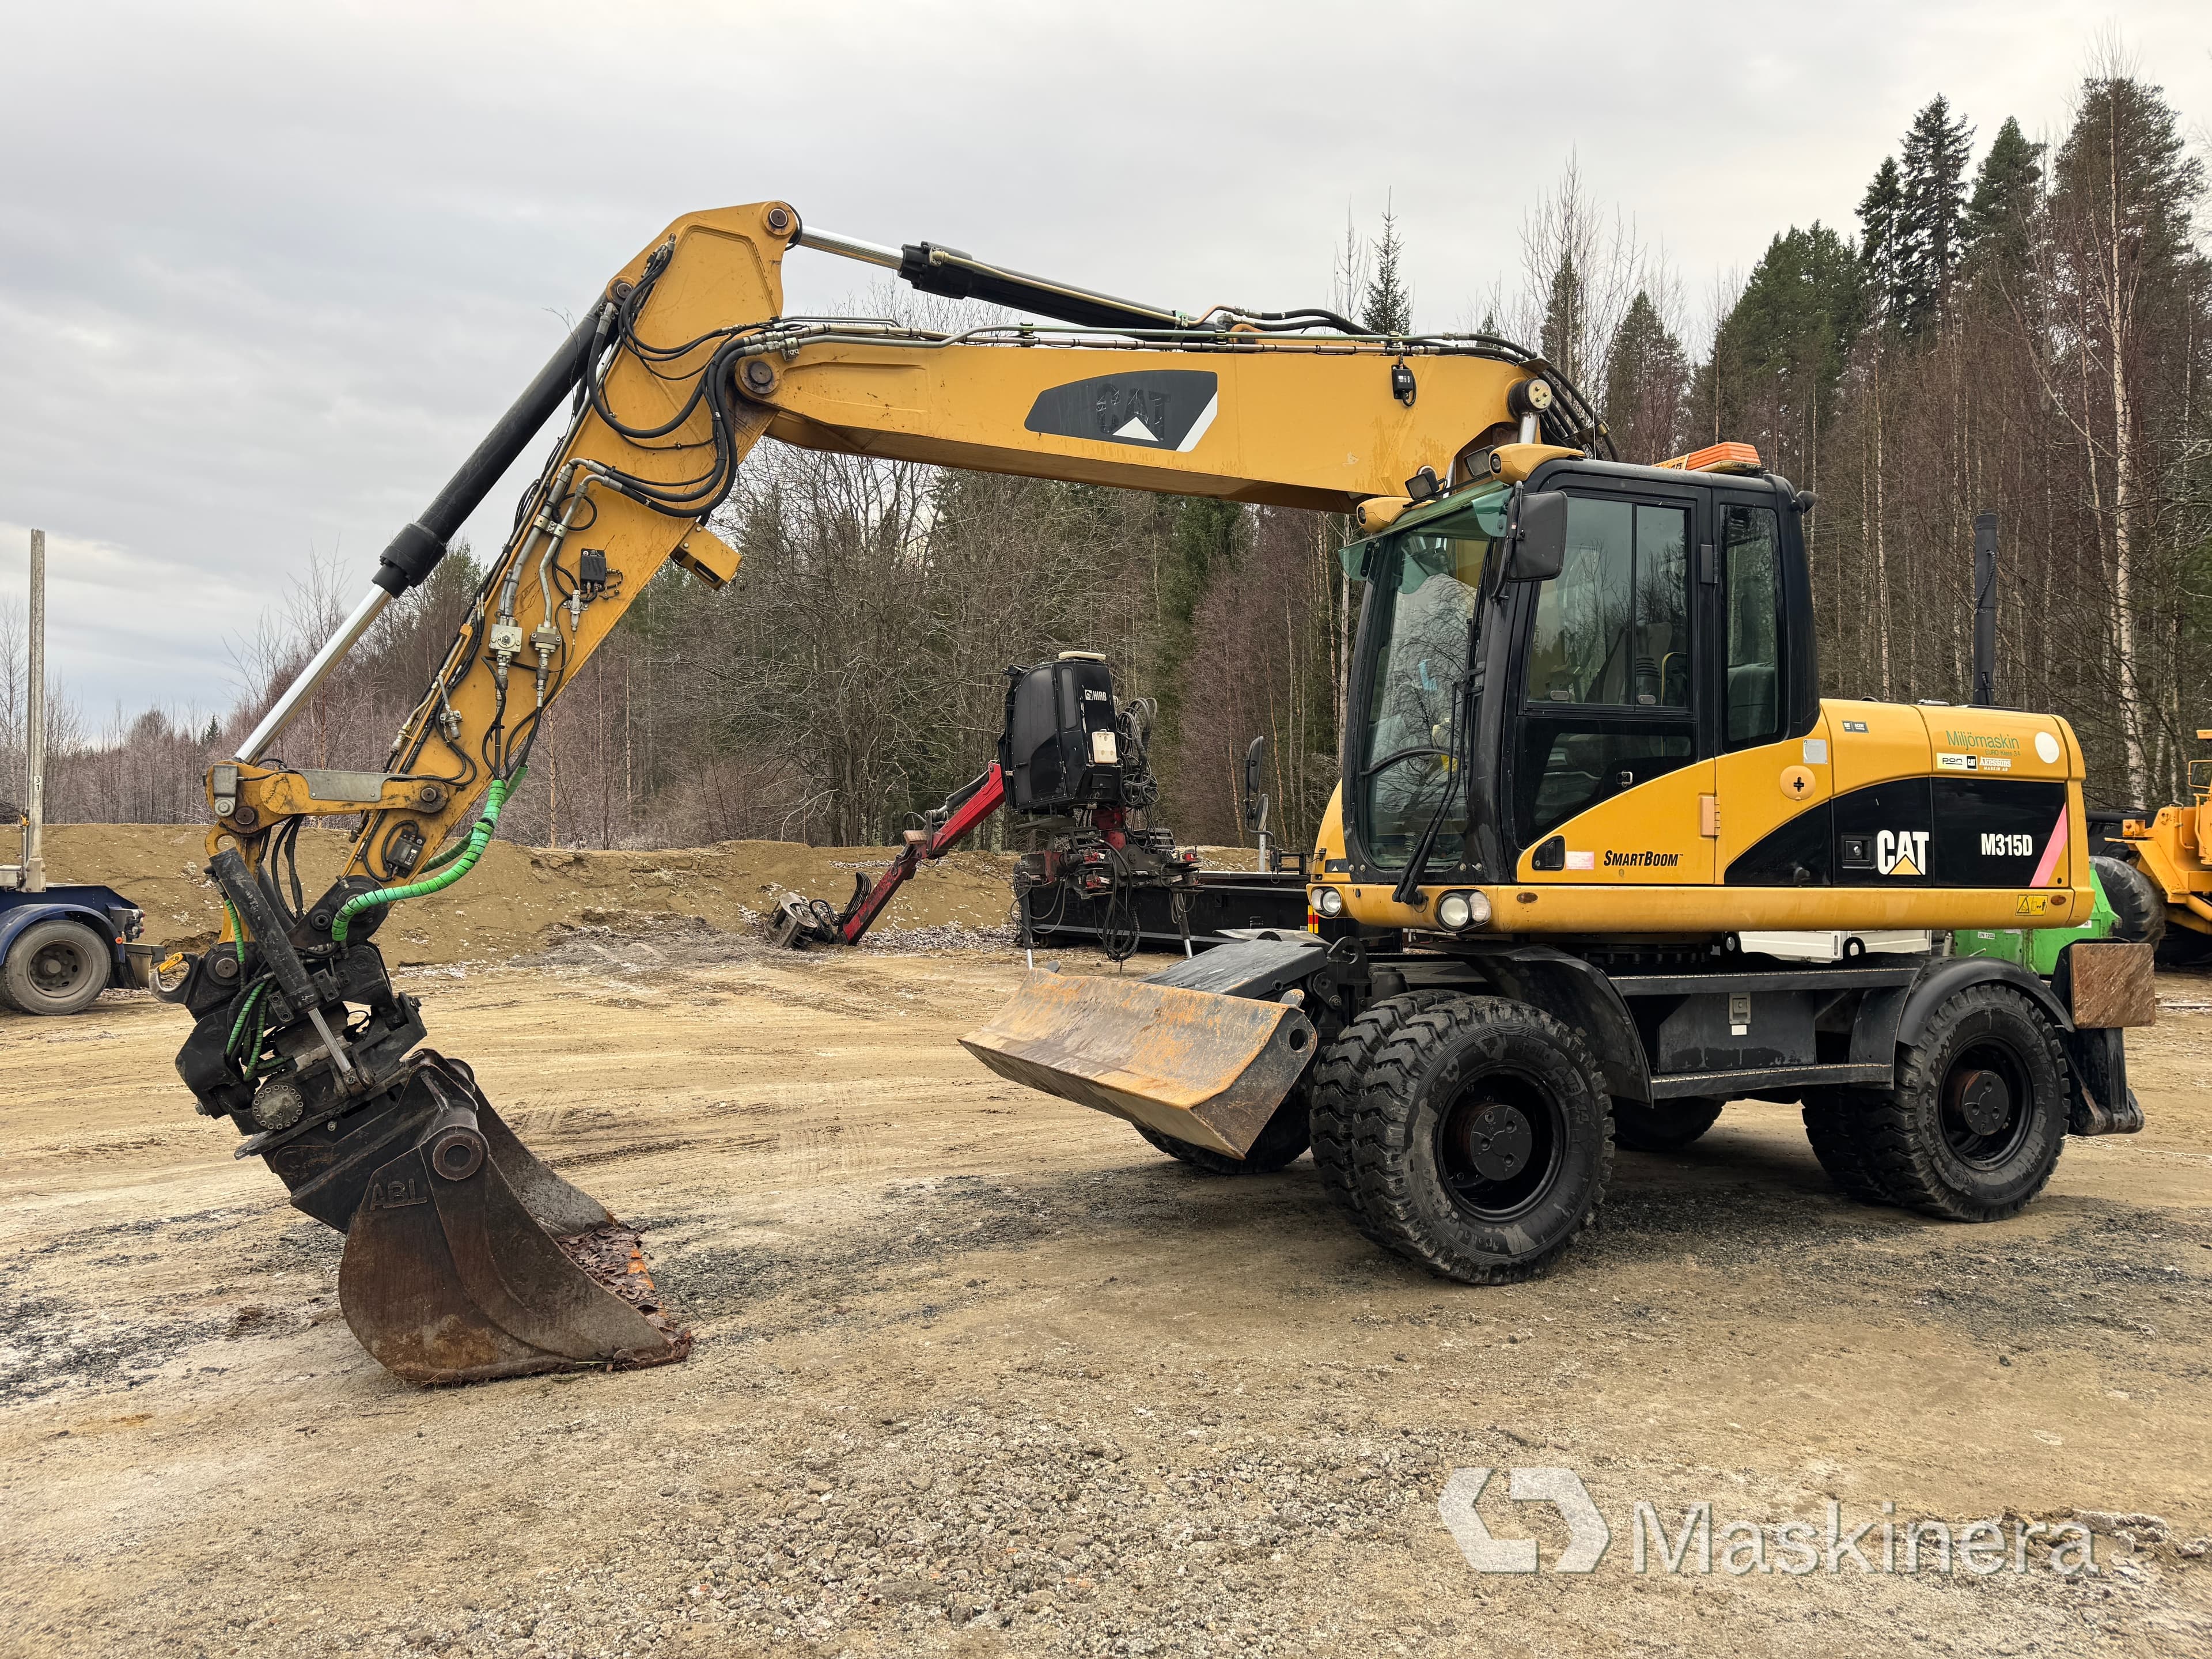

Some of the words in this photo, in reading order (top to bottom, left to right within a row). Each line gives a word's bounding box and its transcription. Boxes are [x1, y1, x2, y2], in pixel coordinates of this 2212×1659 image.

[1096, 383, 1171, 442] CAT
[1093, 690, 1107, 701] HIAB
[1946, 730, 2020, 751] Miljömaskin
[1877, 830, 1929, 875] CAT
[1981, 833, 2033, 857] M315D
